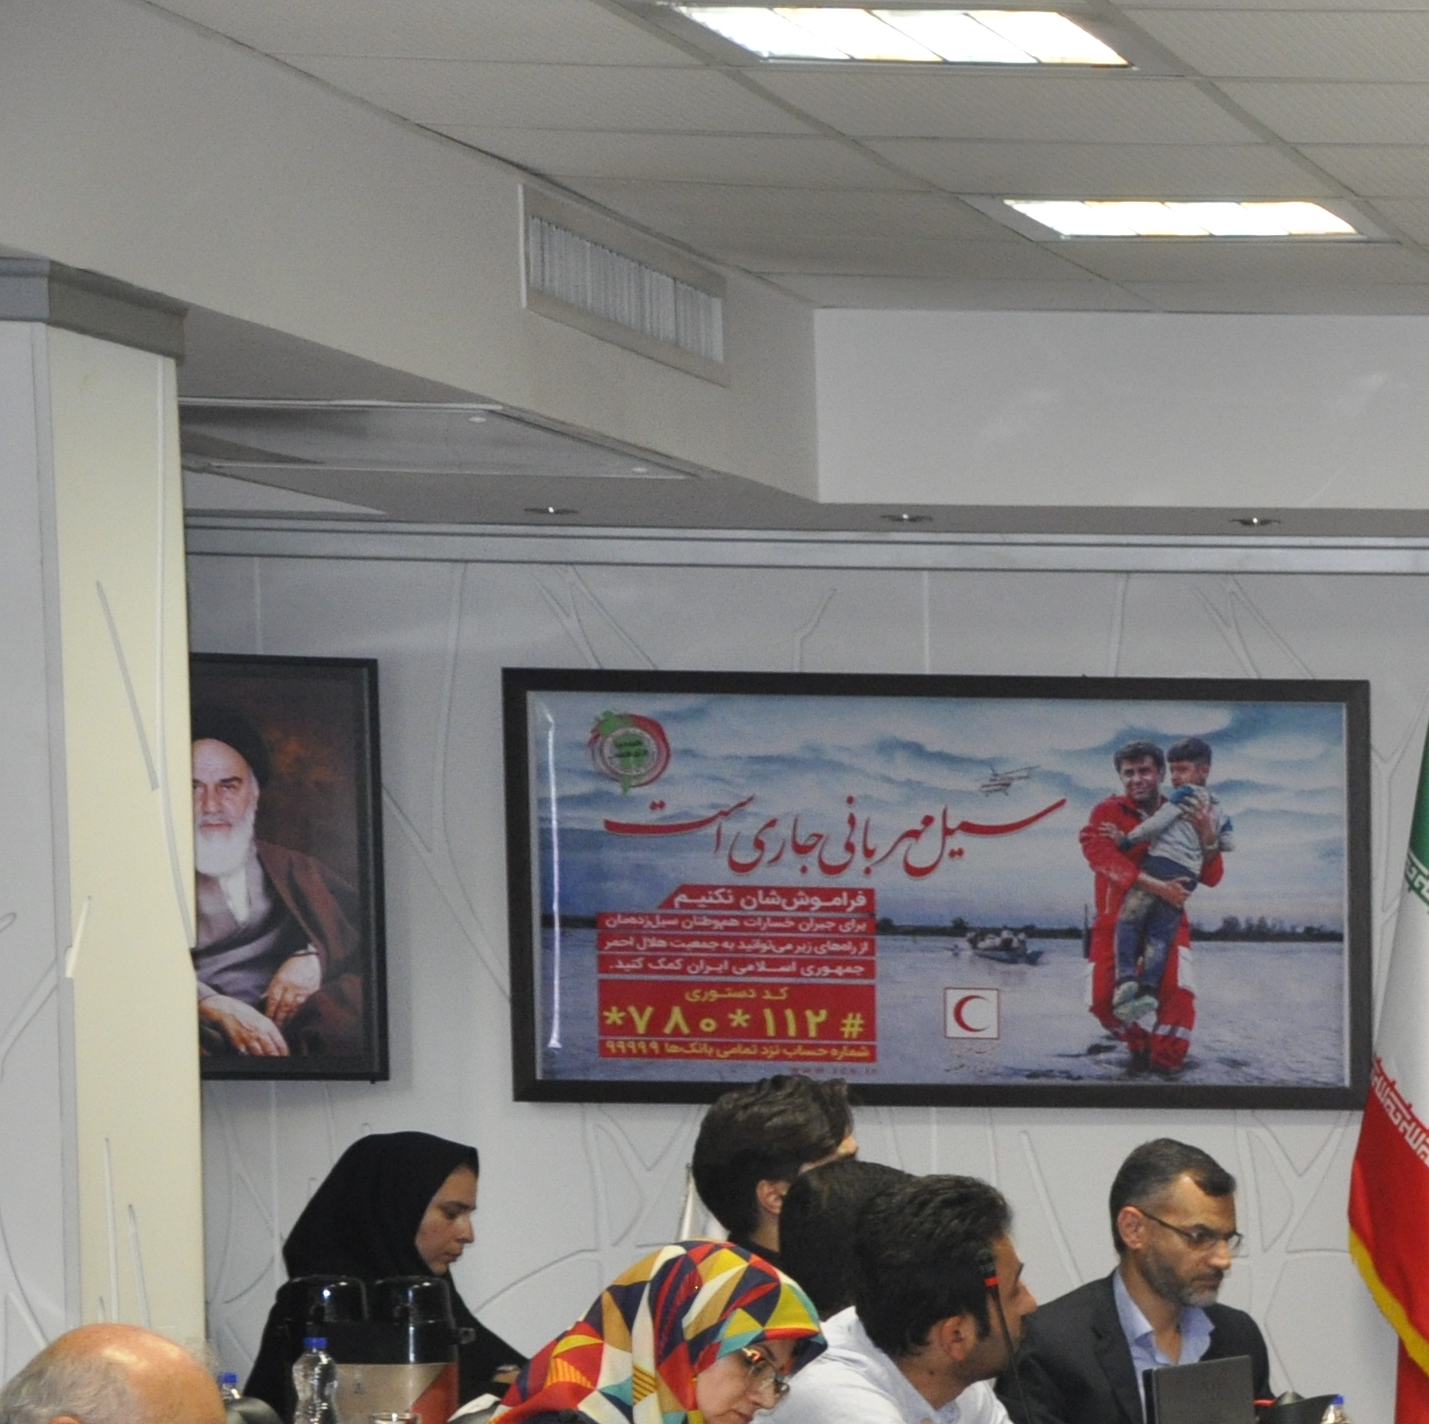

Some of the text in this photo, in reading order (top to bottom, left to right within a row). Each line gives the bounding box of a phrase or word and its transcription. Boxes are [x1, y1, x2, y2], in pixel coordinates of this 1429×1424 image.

[603, 795, 756, 854] است
[728, 814, 824, 874] جاری
[903, 798, 1067, 878] سیل
[647, 957, 683, 970] کمک
[686, 959, 729, 974] ایران
[731, 960, 797, 975] اسلامی
[800, 964, 865, 977] جمهوری
[684, 986, 790, 1002] کد دستوری
